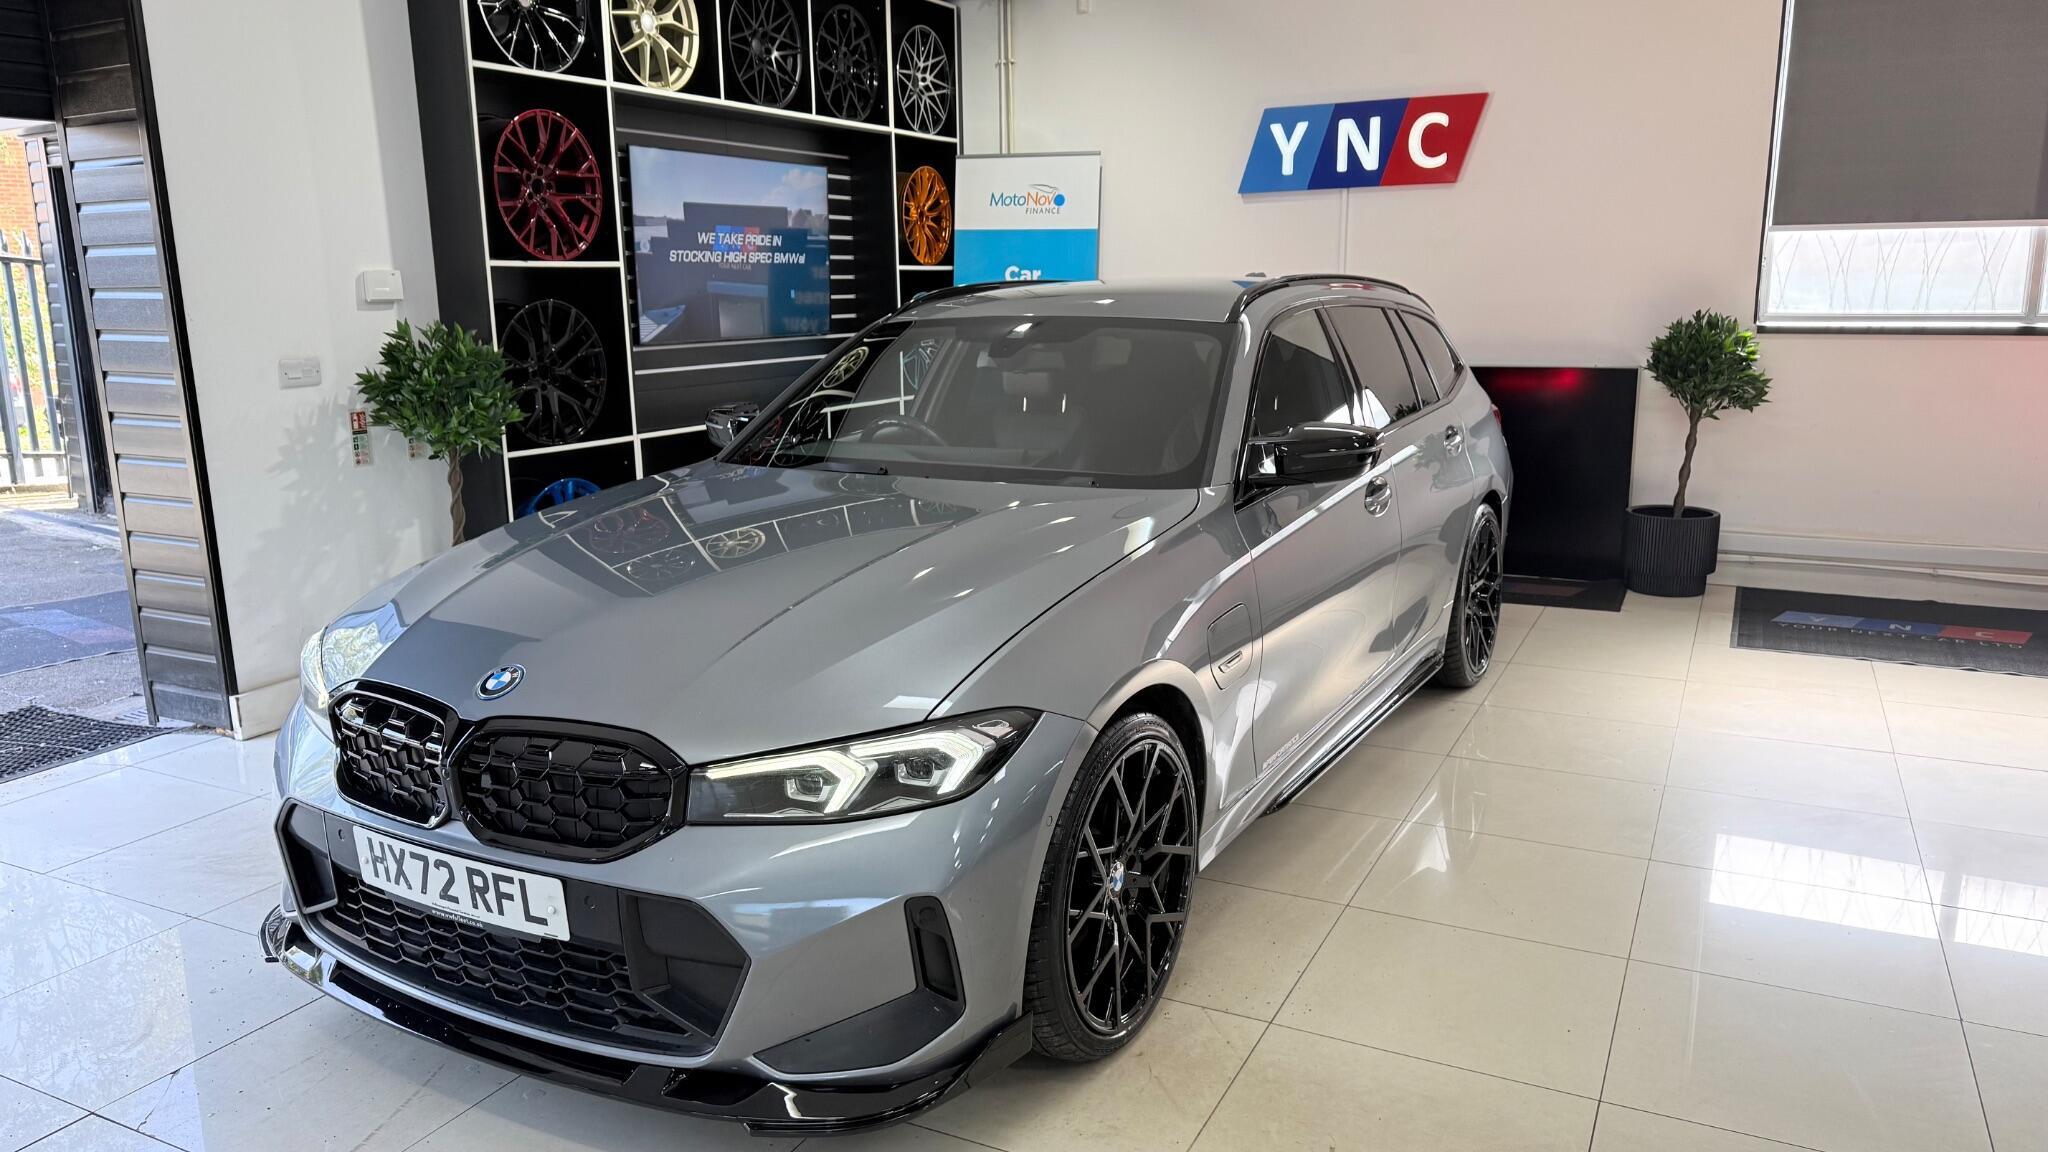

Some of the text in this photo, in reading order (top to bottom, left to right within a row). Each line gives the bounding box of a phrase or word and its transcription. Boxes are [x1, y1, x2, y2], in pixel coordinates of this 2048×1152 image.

[1269, 111, 1450, 176] YNC
[1025, 207, 1061, 215] FINANCE
[697, 232, 782, 246] WE TAKE PRIDE IN
[669, 250, 722, 263] STOCKING
[723, 251, 747, 263] HIGH
[748, 252, 772, 264] SPEC
[1004, 265, 1042, 281] Car
[367, 836, 549, 927] HX72 RFL
